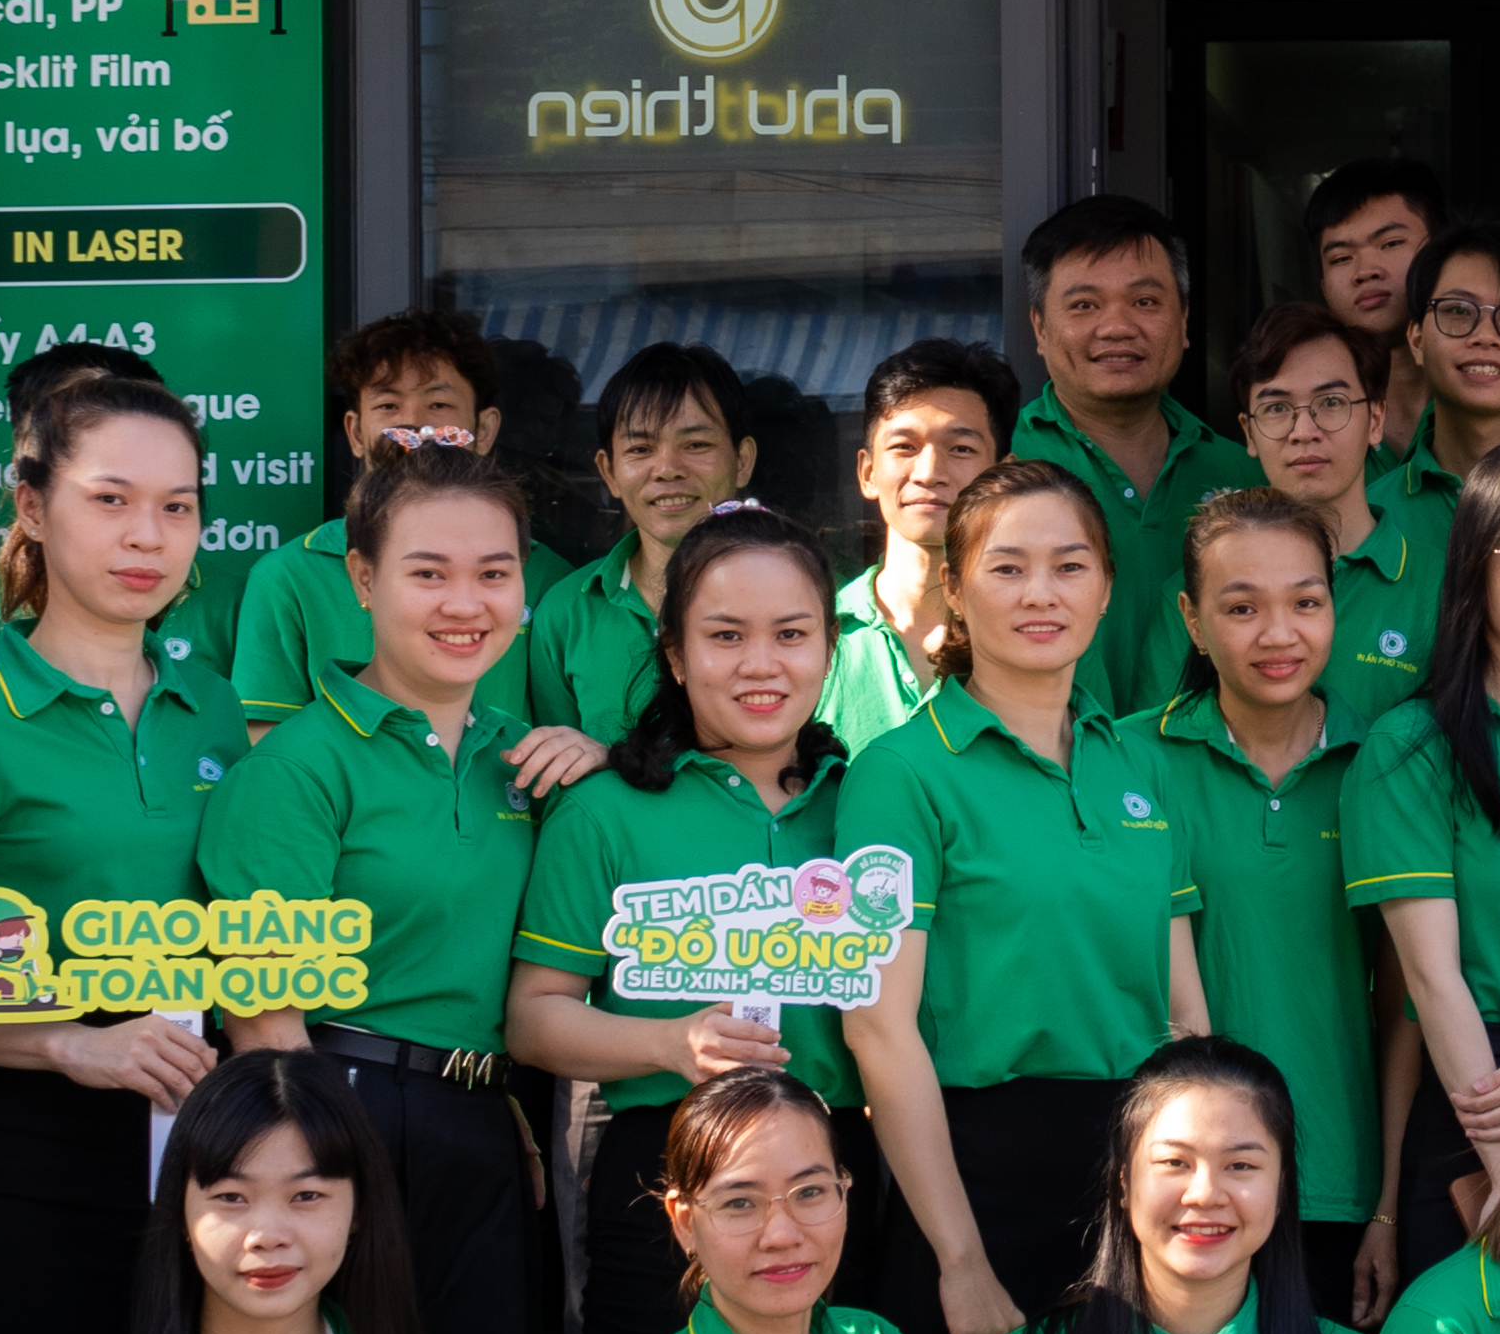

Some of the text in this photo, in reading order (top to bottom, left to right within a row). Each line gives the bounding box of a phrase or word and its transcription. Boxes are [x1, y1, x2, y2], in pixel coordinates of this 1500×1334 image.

[90, 54, 170, 87] Film
[5, 122, 81, 163] lụa,
[96, 114, 158, 152] vải
[174, 110, 233, 151] bố
[13, 229, 183, 263] IN LASER
[232, 451, 314, 484] visit
[627, 873, 790, 921] TEM DÁN
[74, 900, 362, 947] GIAO HÀNG
[72, 955, 357, 1007] TOÀN QUỐC
[628, 966, 869, 999] SIÊU XINH SIÊU SỊN
